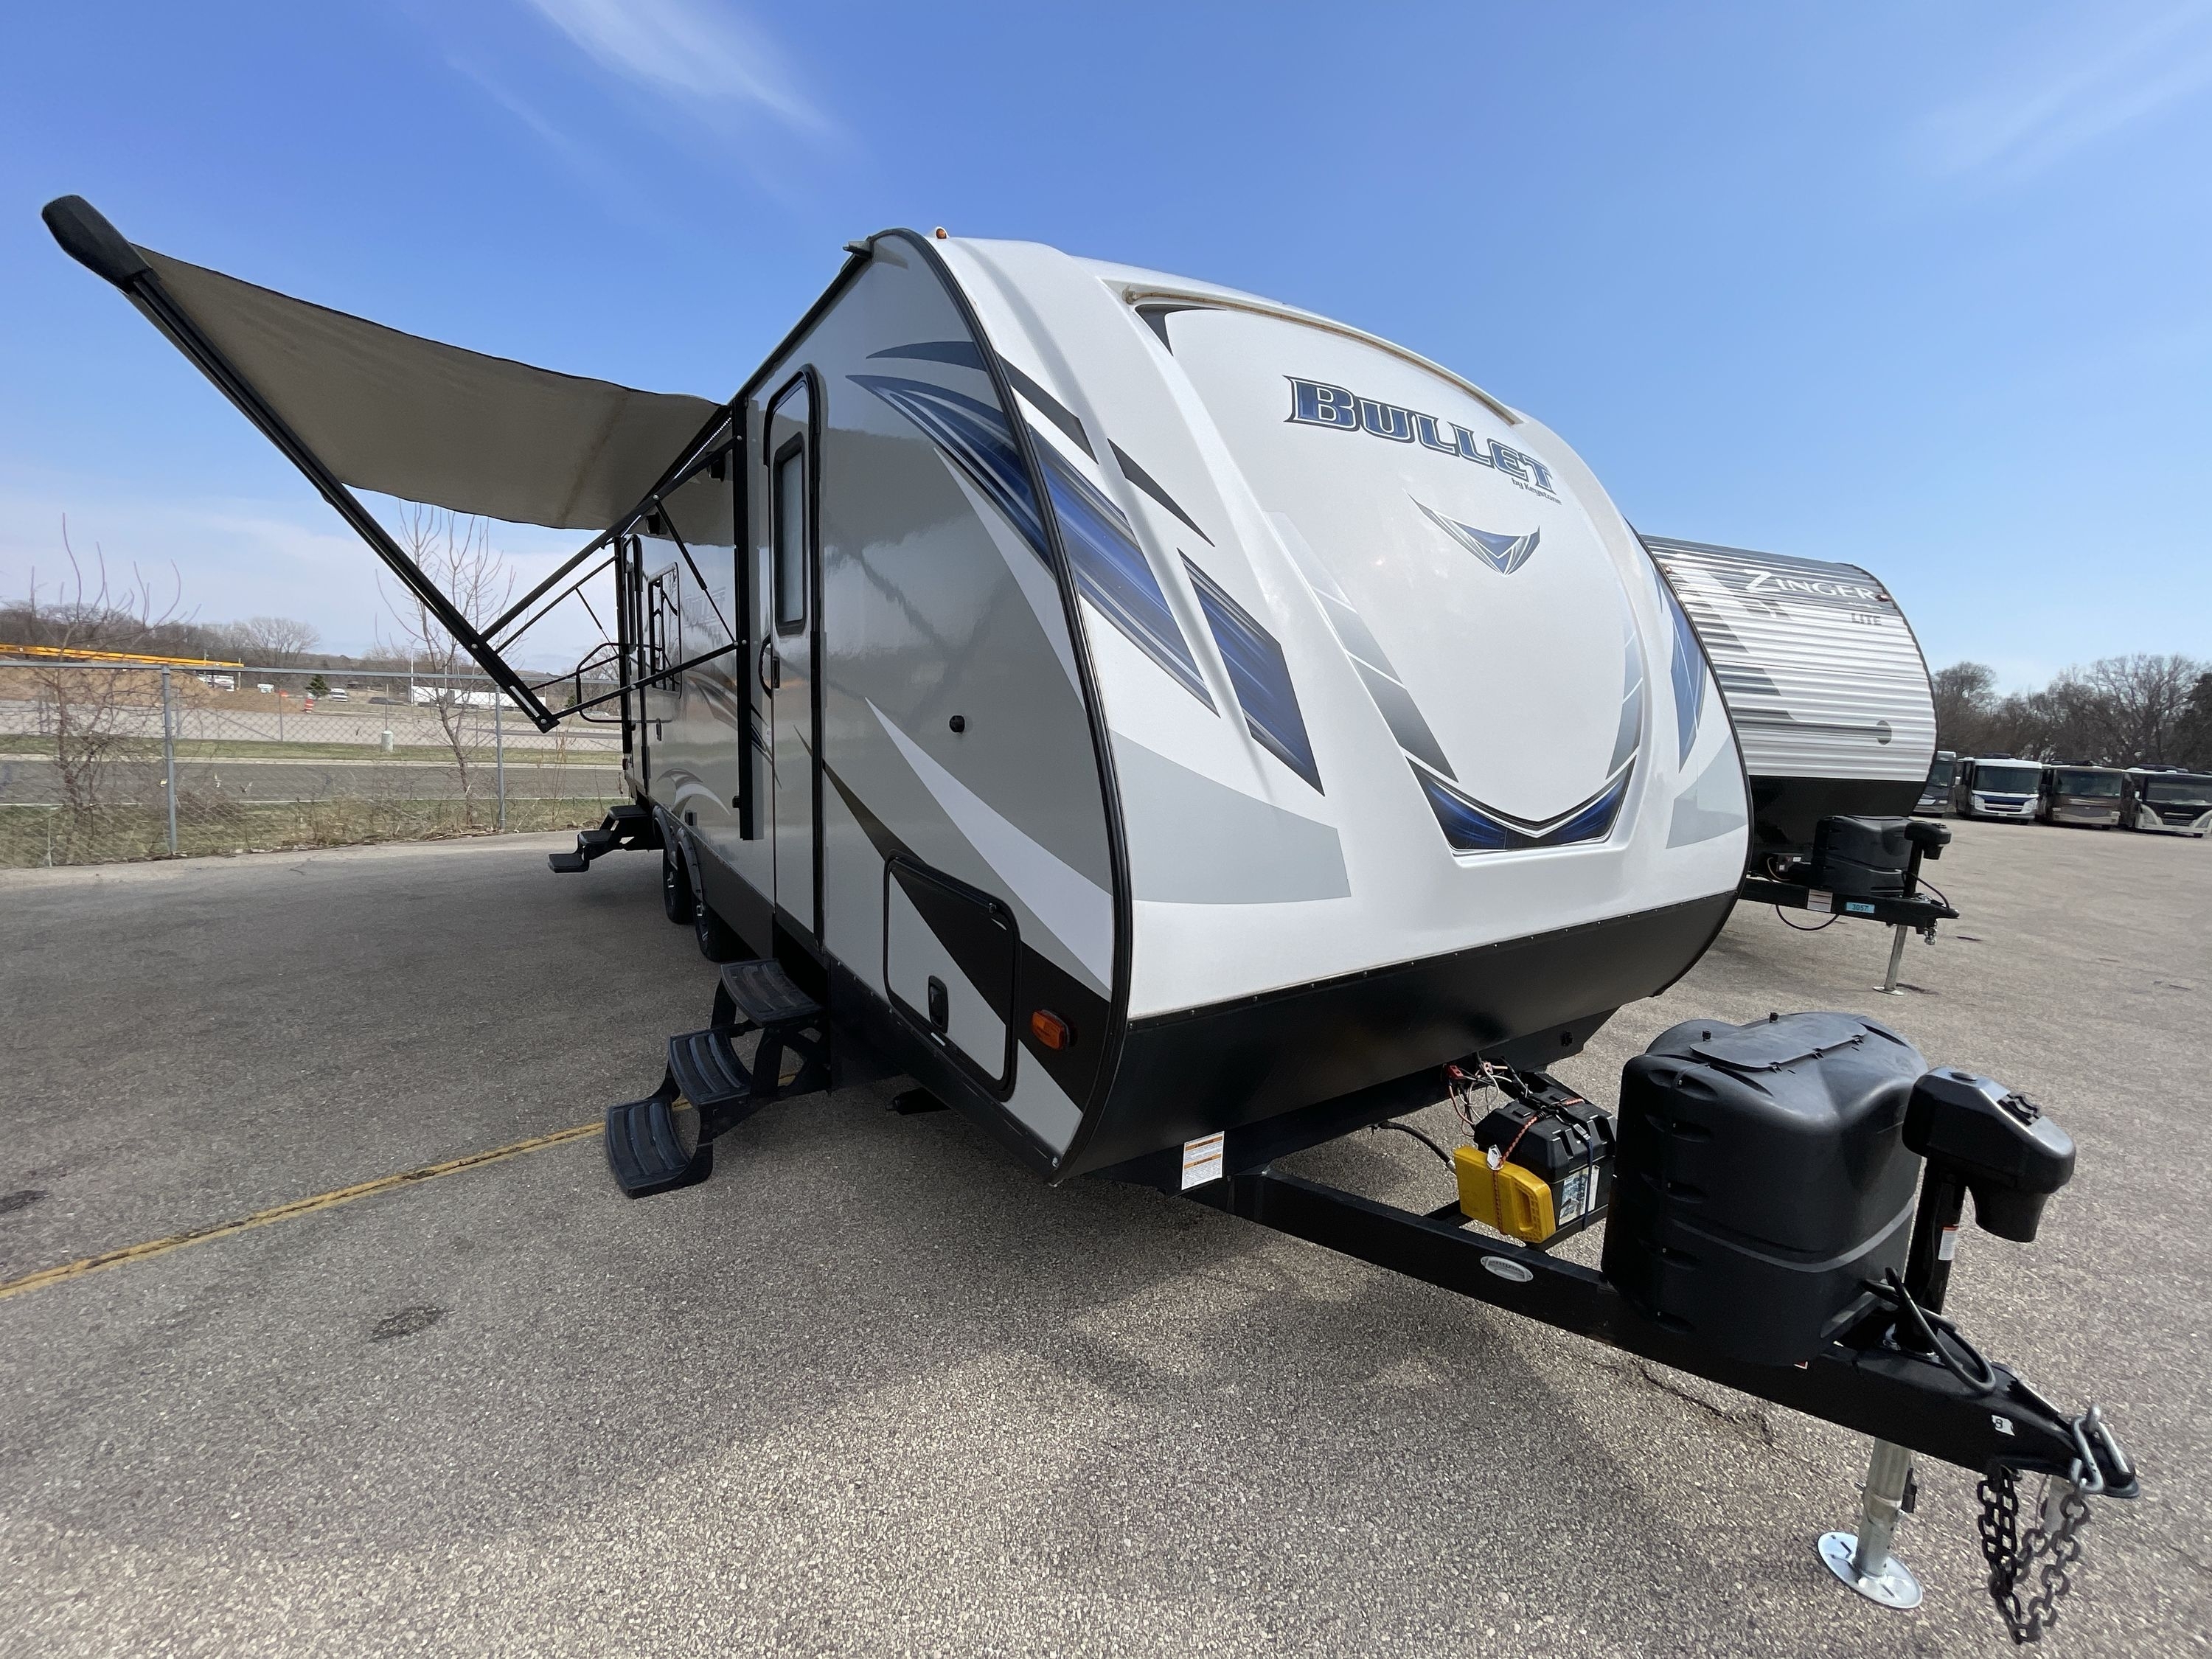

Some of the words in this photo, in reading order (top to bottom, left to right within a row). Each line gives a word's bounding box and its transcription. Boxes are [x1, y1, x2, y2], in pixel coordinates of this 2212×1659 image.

[1282, 375, 1557, 495] BULLET
[1743, 568, 1878, 602] ZINGER
[1851, 613, 1882, 626] LITE
